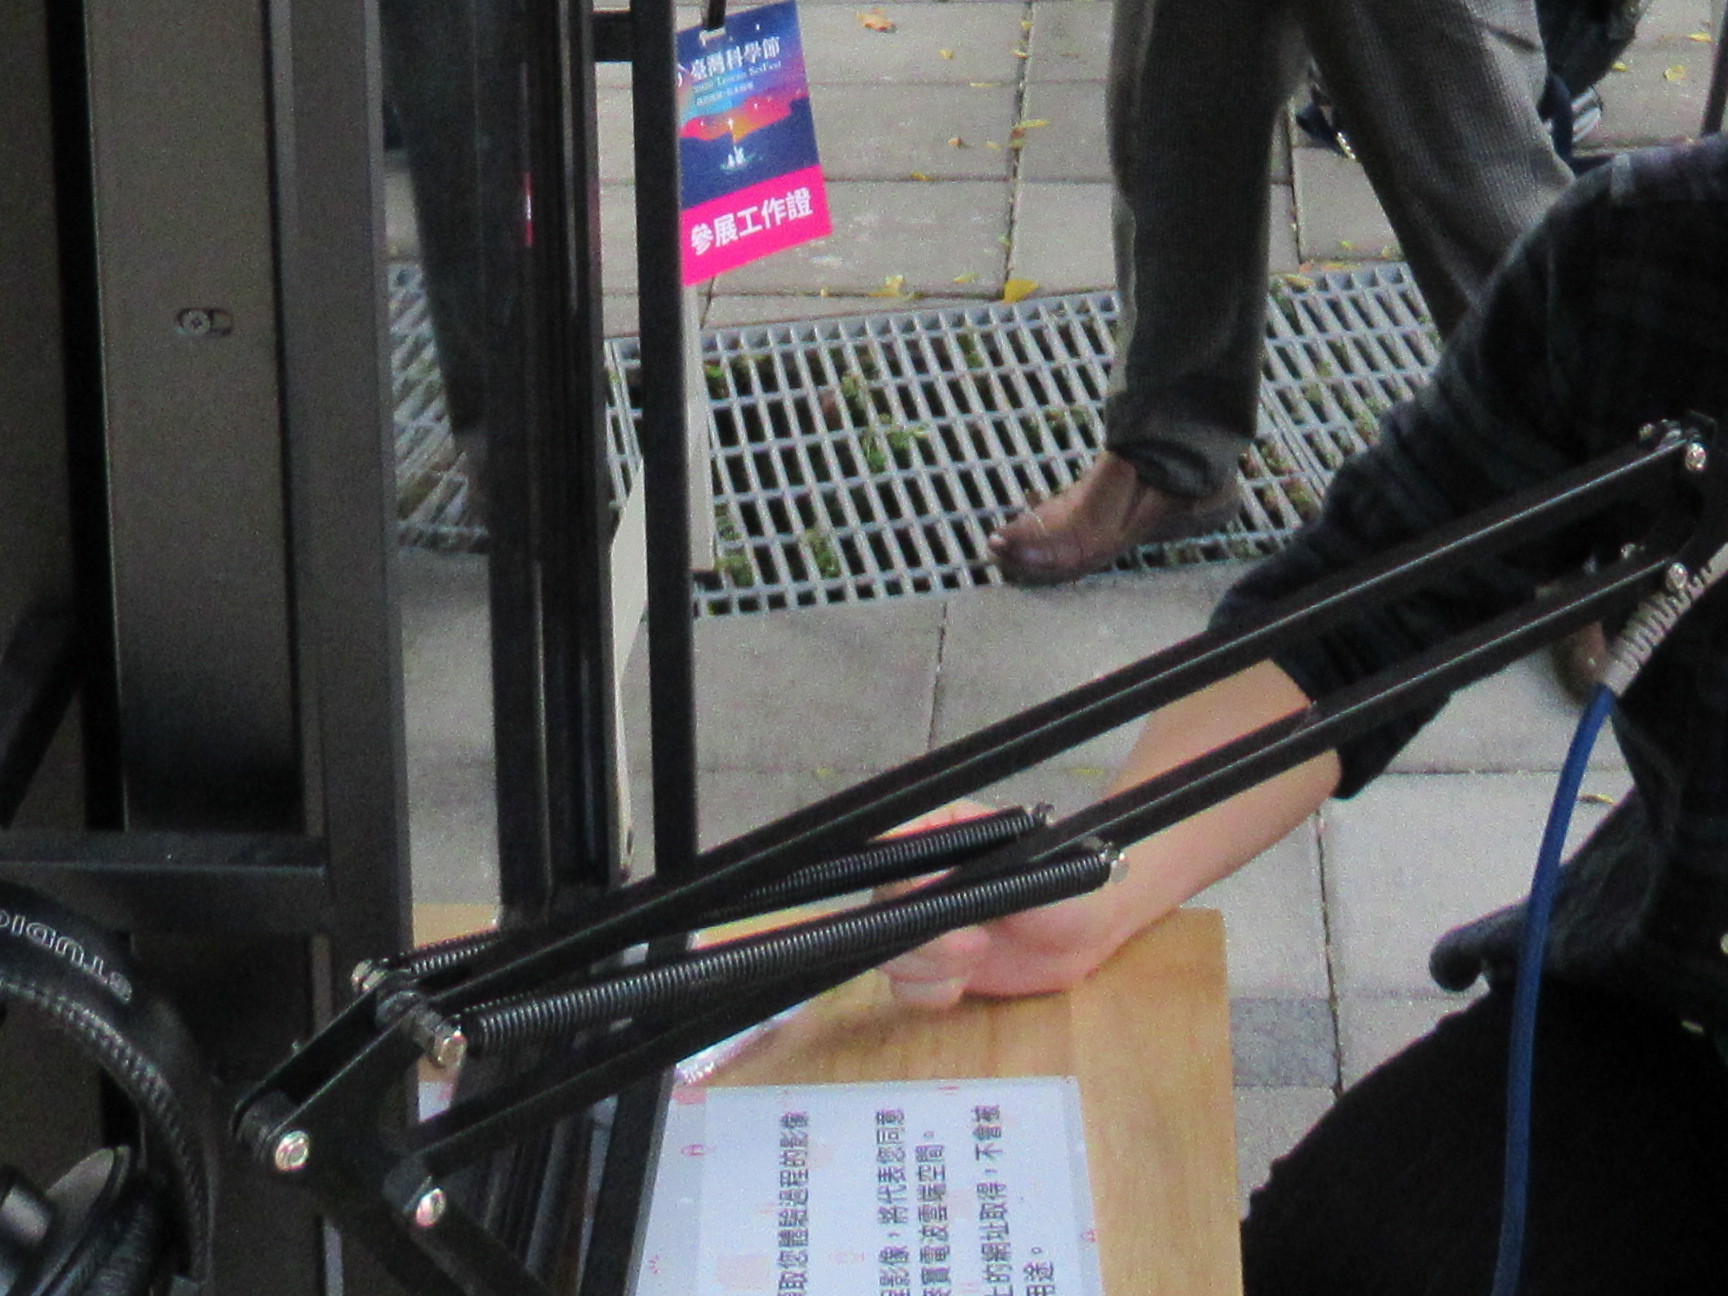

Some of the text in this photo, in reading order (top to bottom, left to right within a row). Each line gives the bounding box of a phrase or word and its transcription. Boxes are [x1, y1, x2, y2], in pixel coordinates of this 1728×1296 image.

[690, 186, 814, 256] 參展工作證
[776, 1110, 812, 1296] 取您體驗過程的影像
